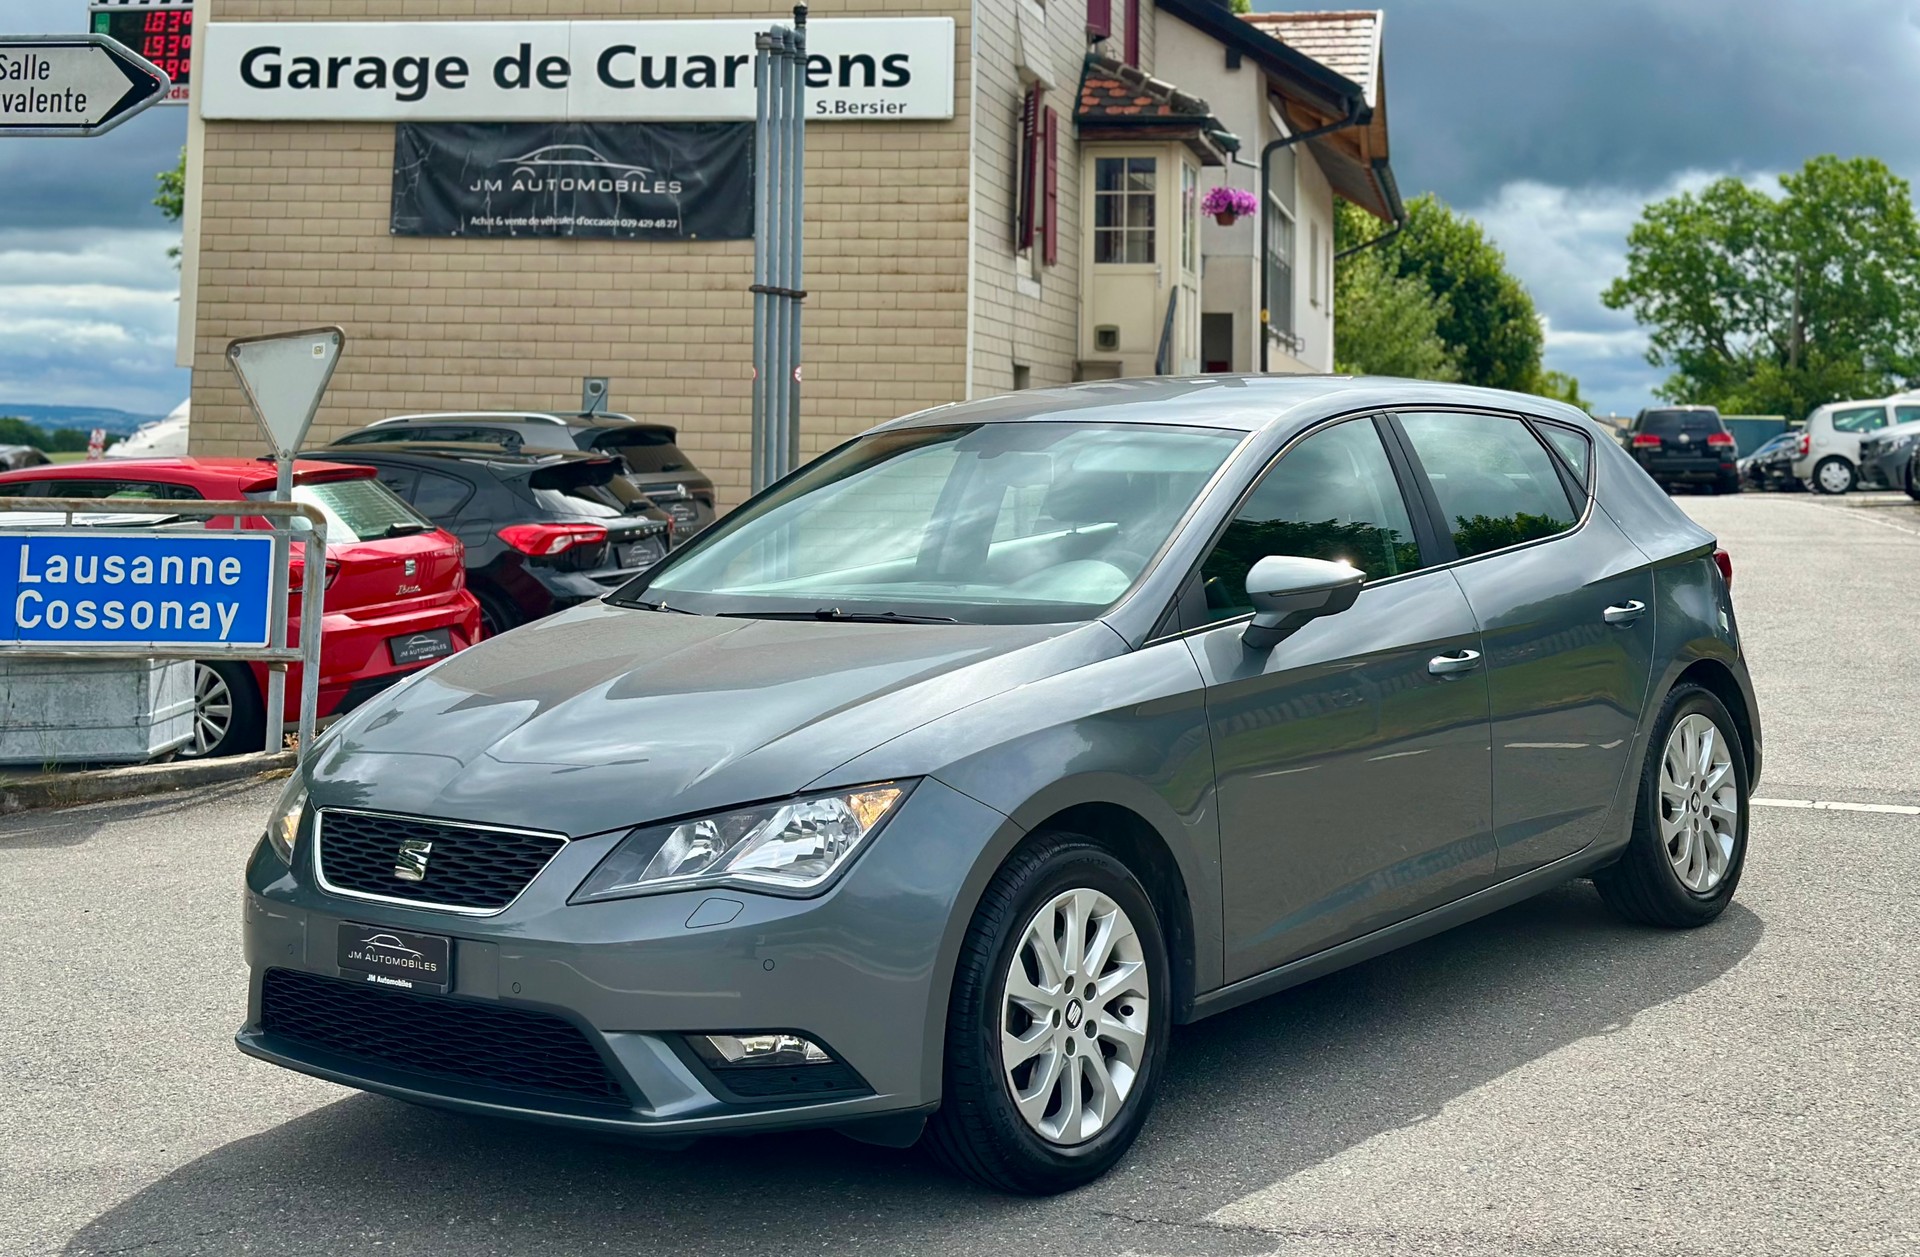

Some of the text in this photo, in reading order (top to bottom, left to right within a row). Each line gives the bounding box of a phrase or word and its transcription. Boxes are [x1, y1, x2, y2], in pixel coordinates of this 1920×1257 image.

[0, 54, 50, 80] Salle
[239, 43, 912, 102] Garage de Cuarens
[2, 86, 87, 113] valente
[815, 100, 908, 115] S.Bersier
[470, 178, 683, 194] JM AUTOMOBILES
[470, 216, 494, 226] Achat
[495, 216, 503, 226] &
[504, 216, 528, 226] vente
[528, 215, 540, 226] de
[620, 218, 637, 228] 079
[638, 218, 654, 228] 429
[654, 218, 666, 229] 48
[667, 219, 678, 229] 27
[18, 544, 242, 586] Lausanne
[15, 589, 240, 640] Cossonay
[348, 951, 438, 972] JM AUTOMOBILES
[367, 974, 413, 989] JM Automobiles
